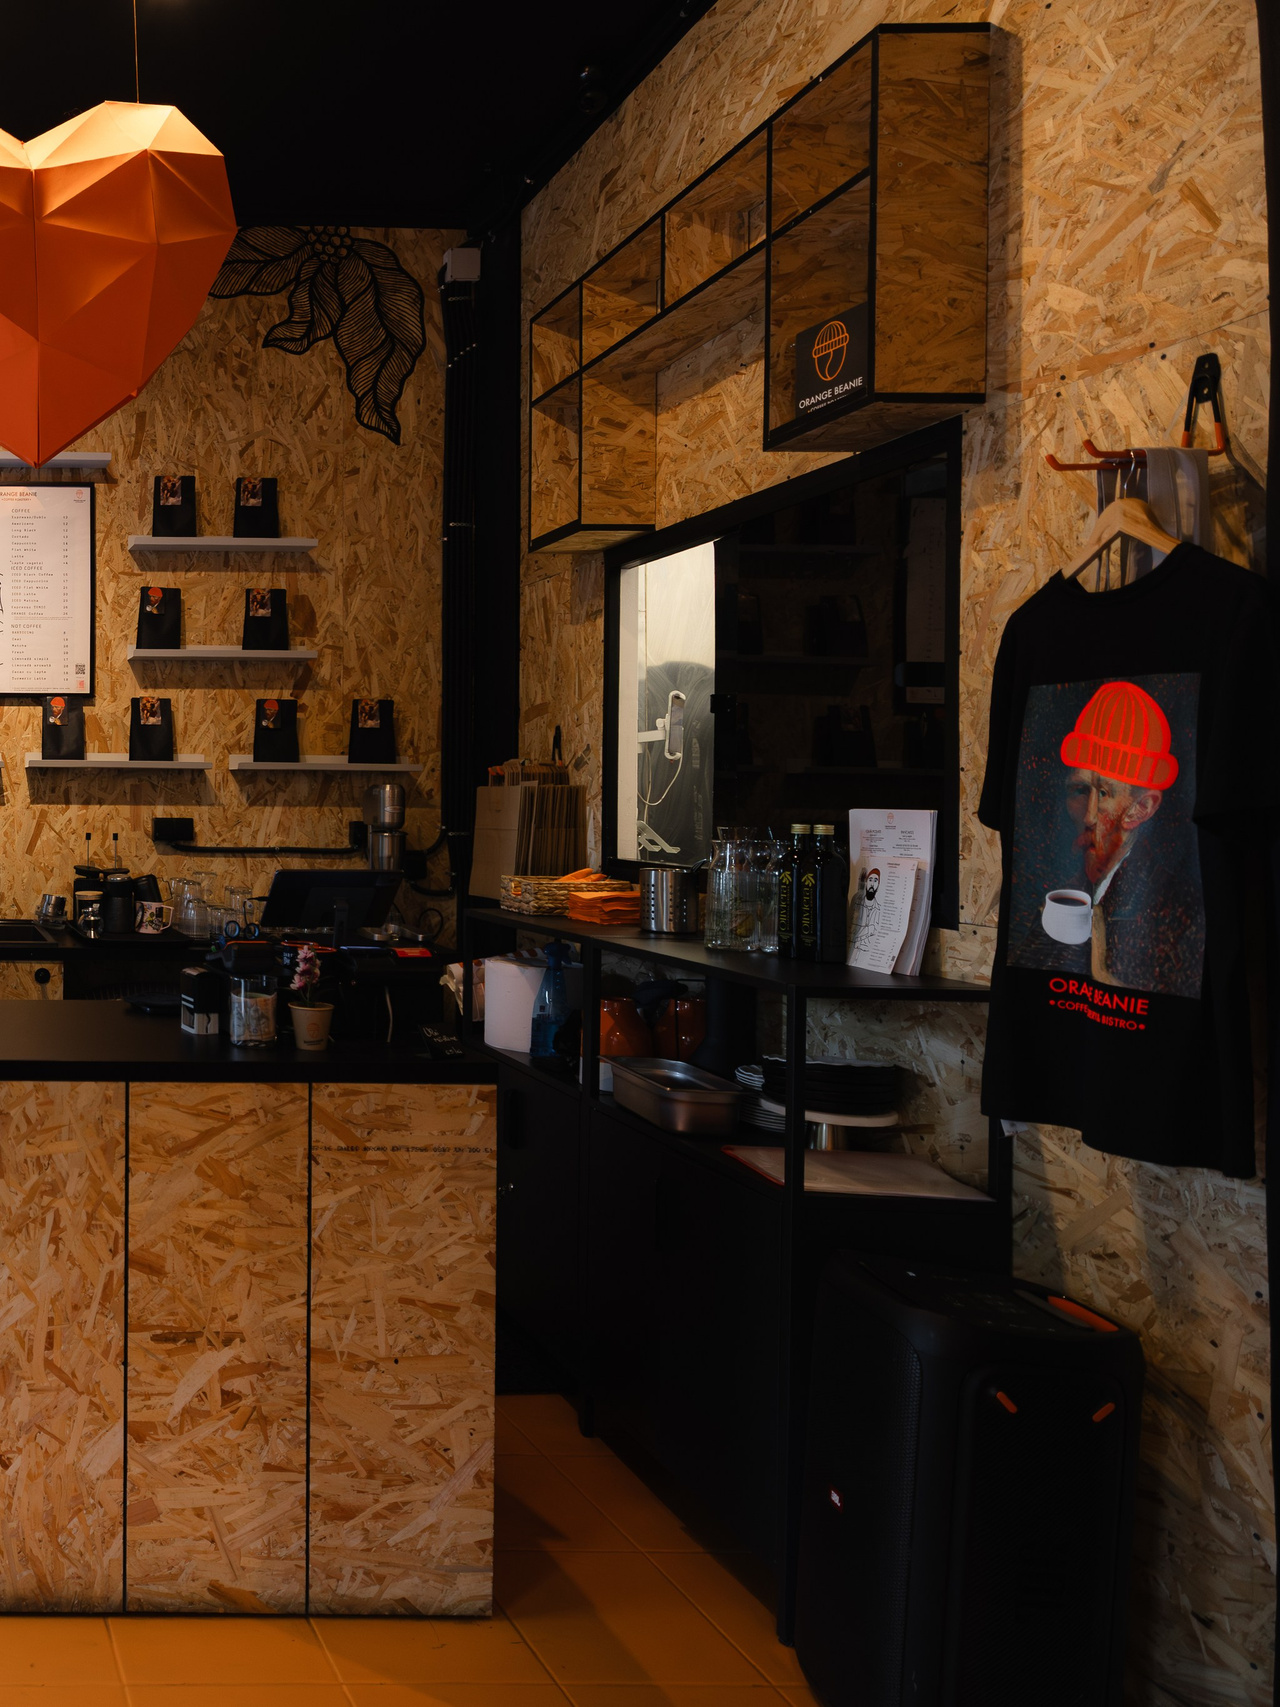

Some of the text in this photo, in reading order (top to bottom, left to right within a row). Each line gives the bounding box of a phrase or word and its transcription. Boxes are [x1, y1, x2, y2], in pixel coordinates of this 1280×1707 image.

[798, 388, 833, 409] ORANGE
[834, 376, 863, 396] BEANIE
[1101, 1014, 1138, 1031] BISTRO
